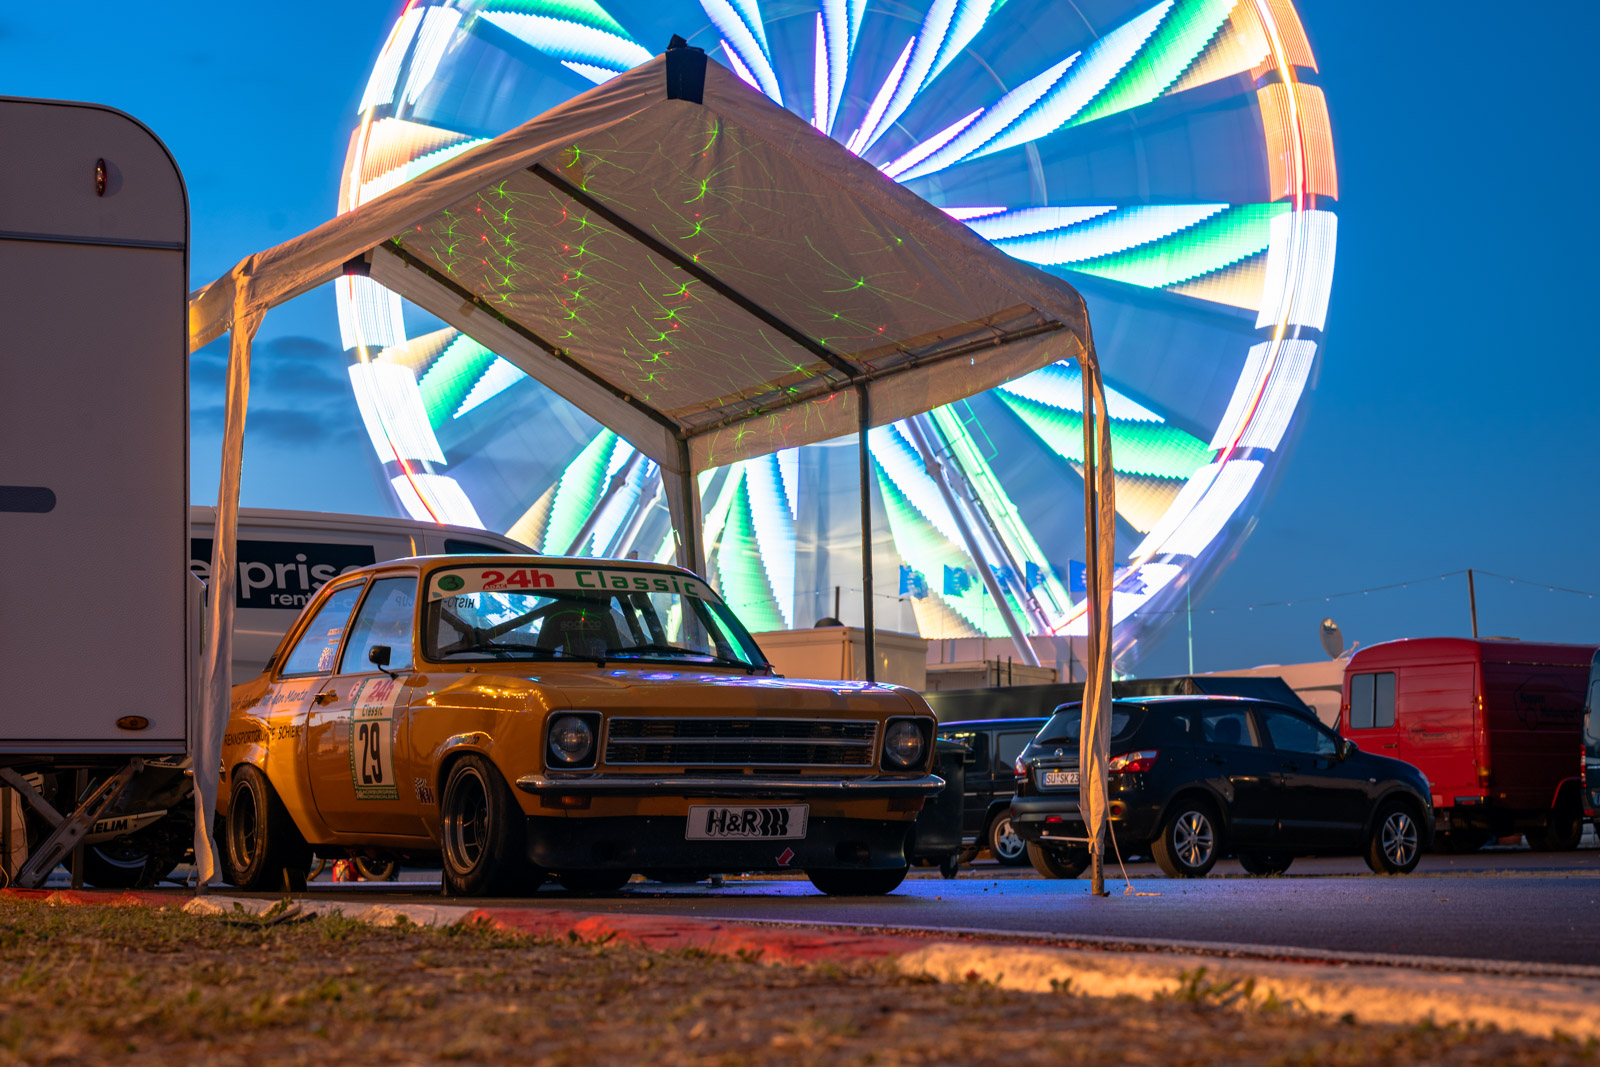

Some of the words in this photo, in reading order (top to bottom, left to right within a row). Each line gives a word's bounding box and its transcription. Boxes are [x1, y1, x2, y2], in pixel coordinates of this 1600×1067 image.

[442, 576, 459, 590] 3
[481, 569, 555, 590] 24h
[575, 571, 699, 596] Classic
[362, 703, 384, 717] Classic
[359, 722, 383, 785] 29
